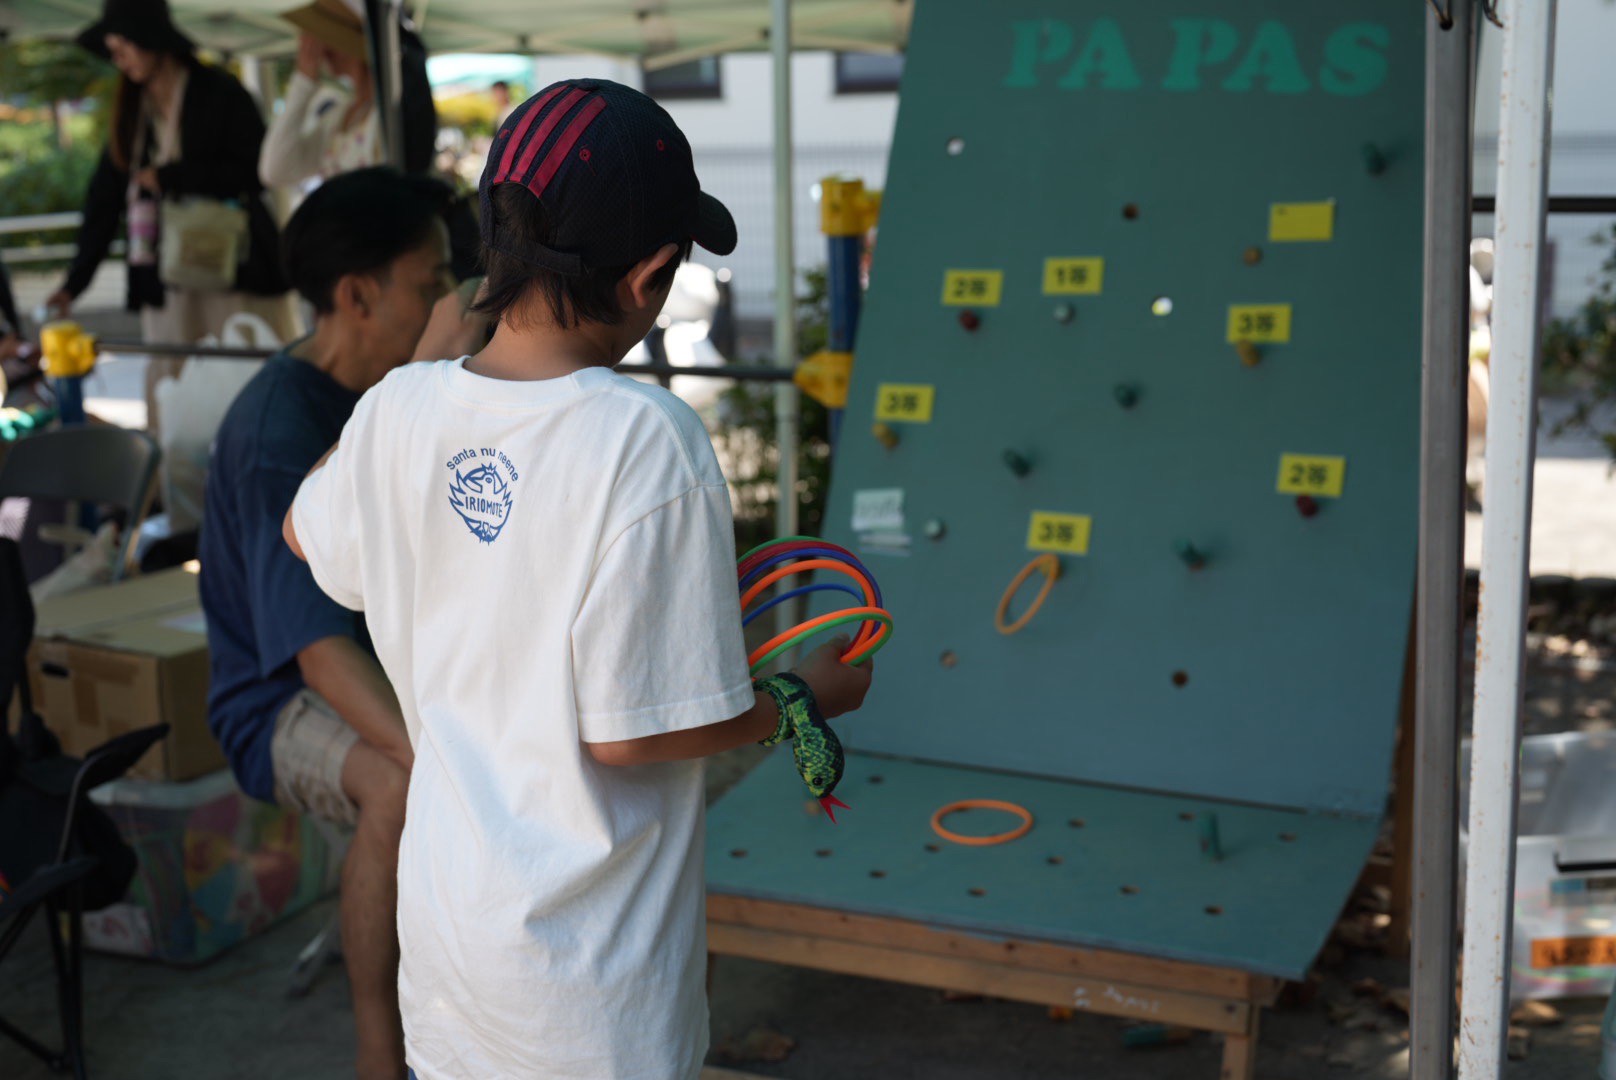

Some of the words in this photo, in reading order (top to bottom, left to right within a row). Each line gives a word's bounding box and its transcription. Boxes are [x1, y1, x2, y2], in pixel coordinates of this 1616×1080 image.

[446, 448, 477, 470] santa
[480, 447, 496, 457] nu
[497, 451, 519, 482] neene
[465, 495, 503, 518] IRIOMOTE
